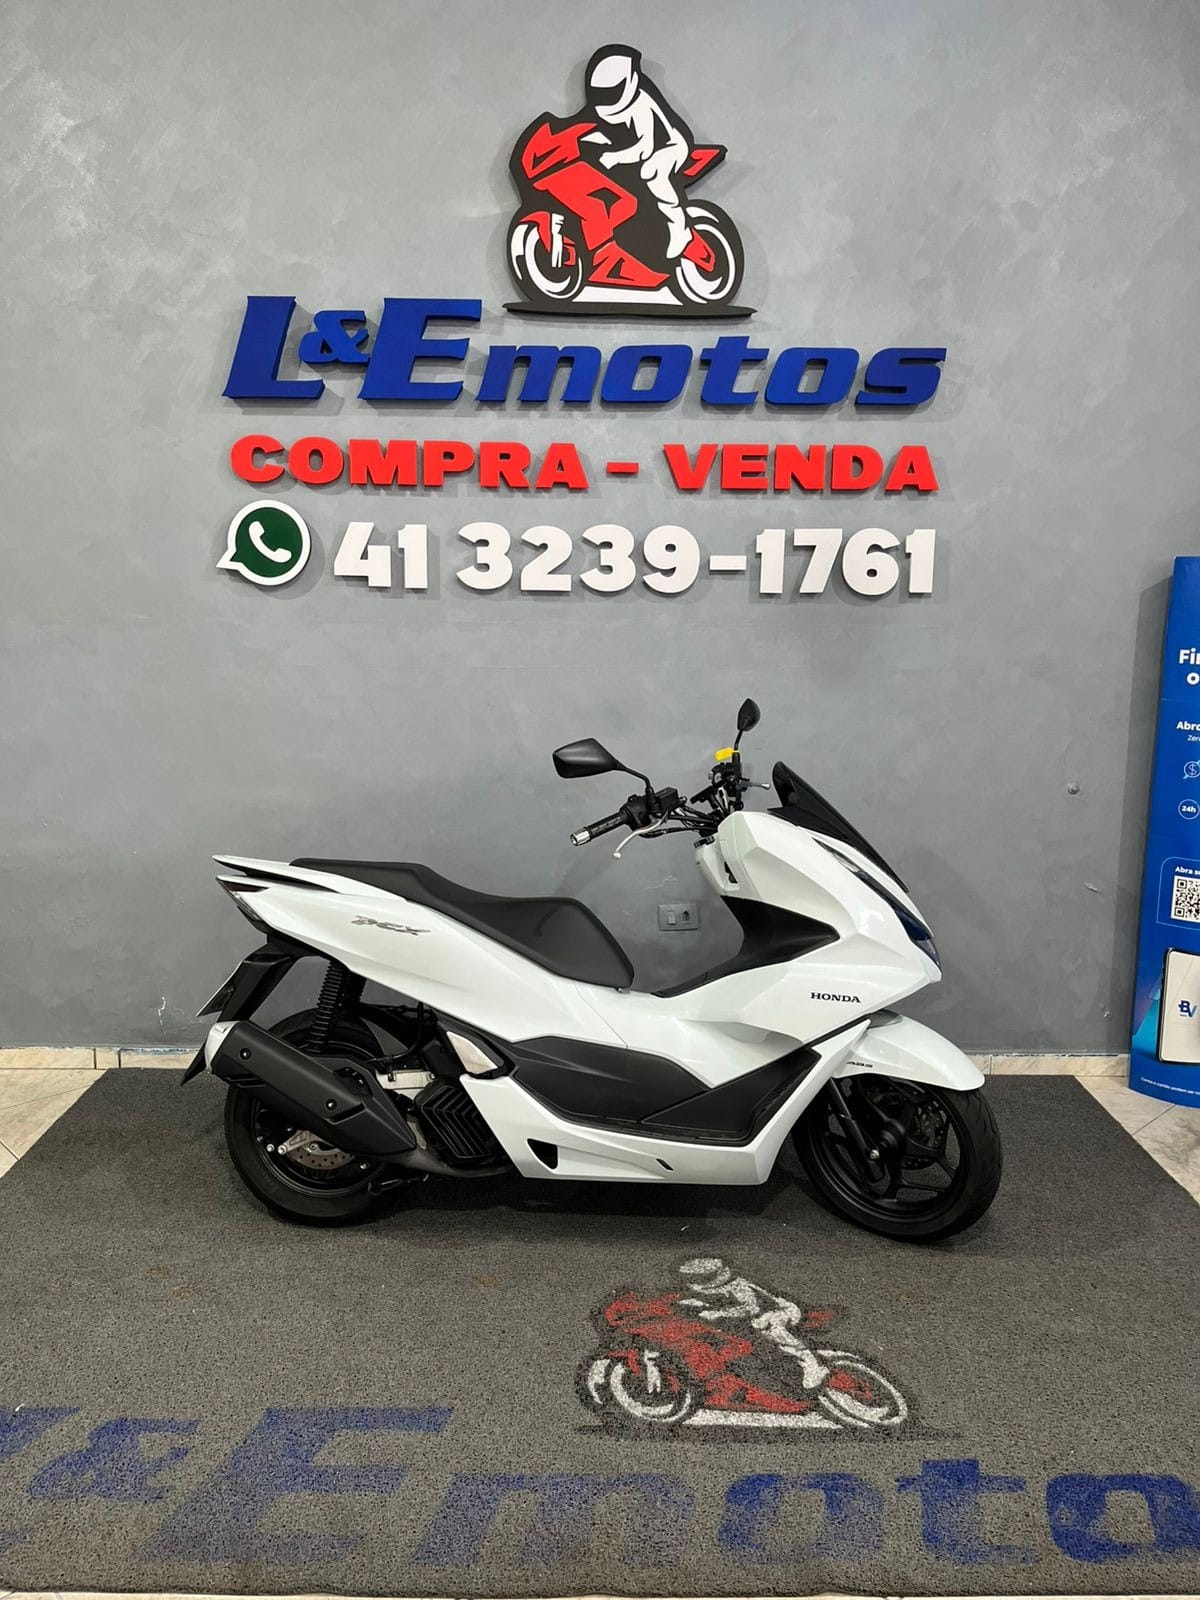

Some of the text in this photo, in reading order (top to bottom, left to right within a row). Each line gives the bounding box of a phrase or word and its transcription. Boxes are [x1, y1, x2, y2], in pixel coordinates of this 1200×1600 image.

[230, 434, 590, 490] COMPRA
[663, 443, 940, 491] VENDA
[333, 520, 937, 595] 41 3239-1761
[810, 992, 861, 1004] HONDA
